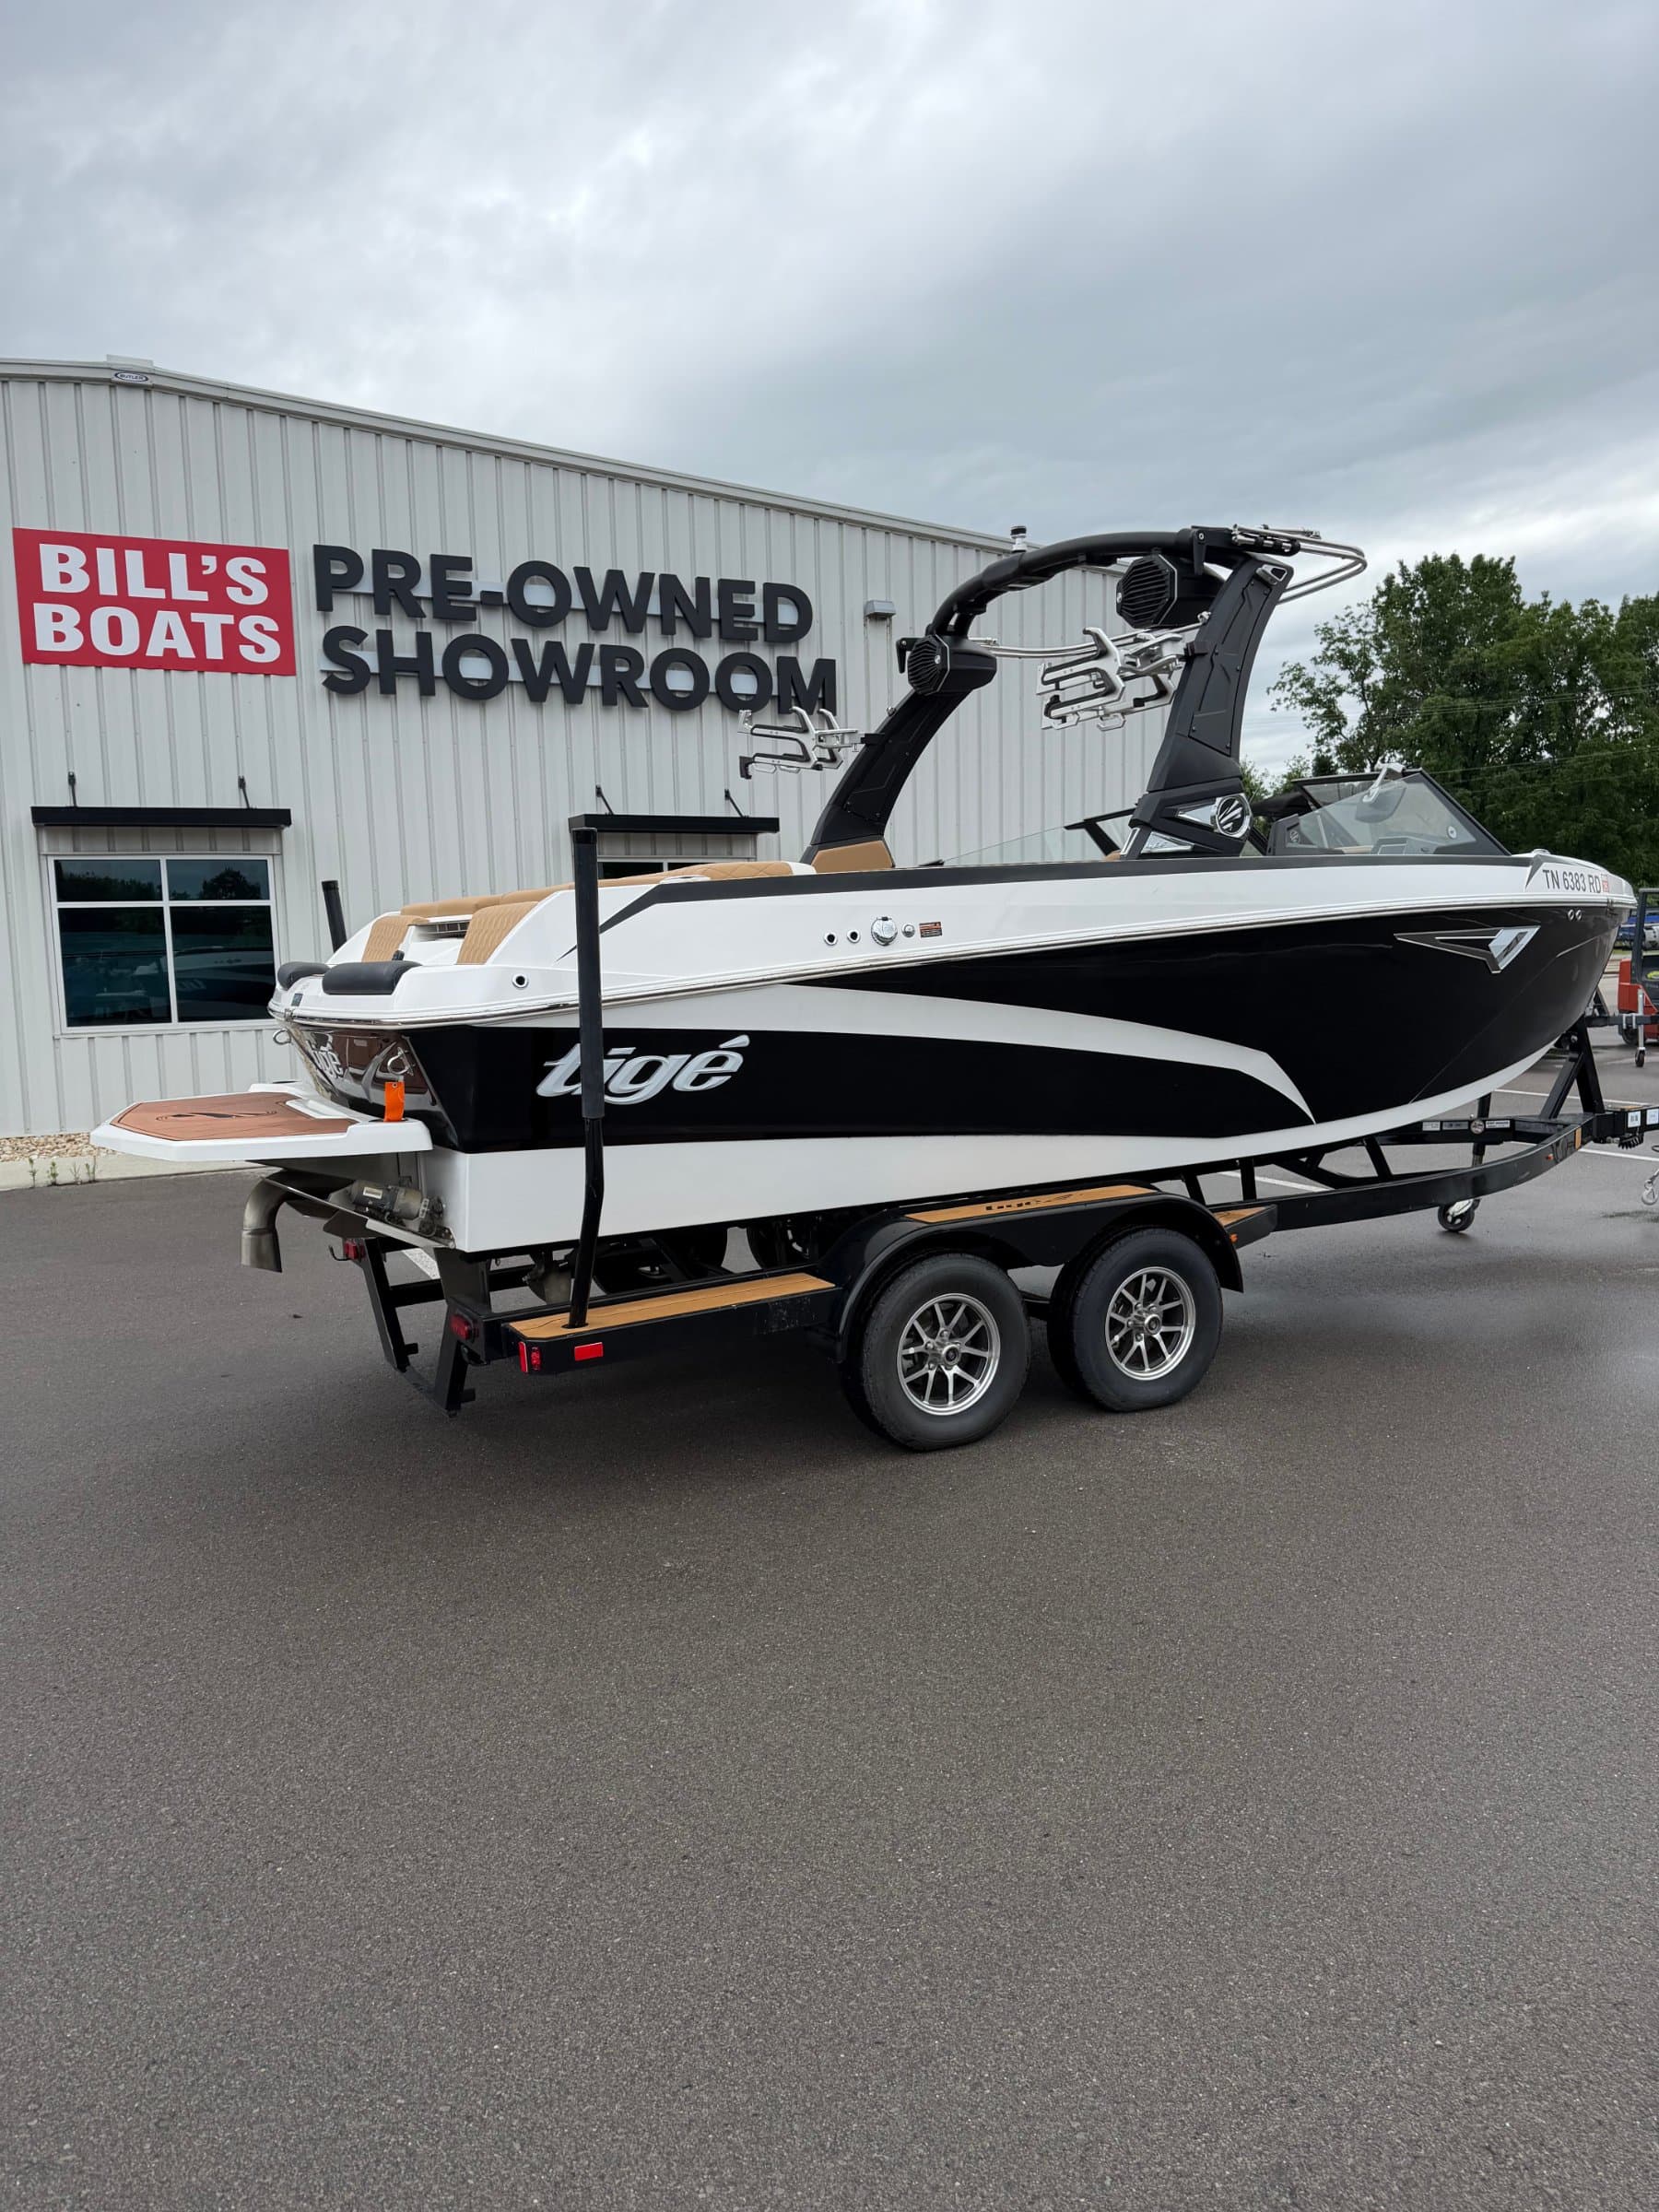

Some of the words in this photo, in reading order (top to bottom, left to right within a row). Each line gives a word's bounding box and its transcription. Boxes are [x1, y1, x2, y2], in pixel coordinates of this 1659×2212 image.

[39, 543, 268, 605] BILL'S
[312, 544, 813, 643] PRE-OWNED
[33, 603, 281, 663] BOATS
[322, 625, 837, 716] SHOWROOM
[1542, 869, 1560, 889] TN
[1562, 871, 1586, 892] 6383
[1587, 874, 1602, 894] RD
